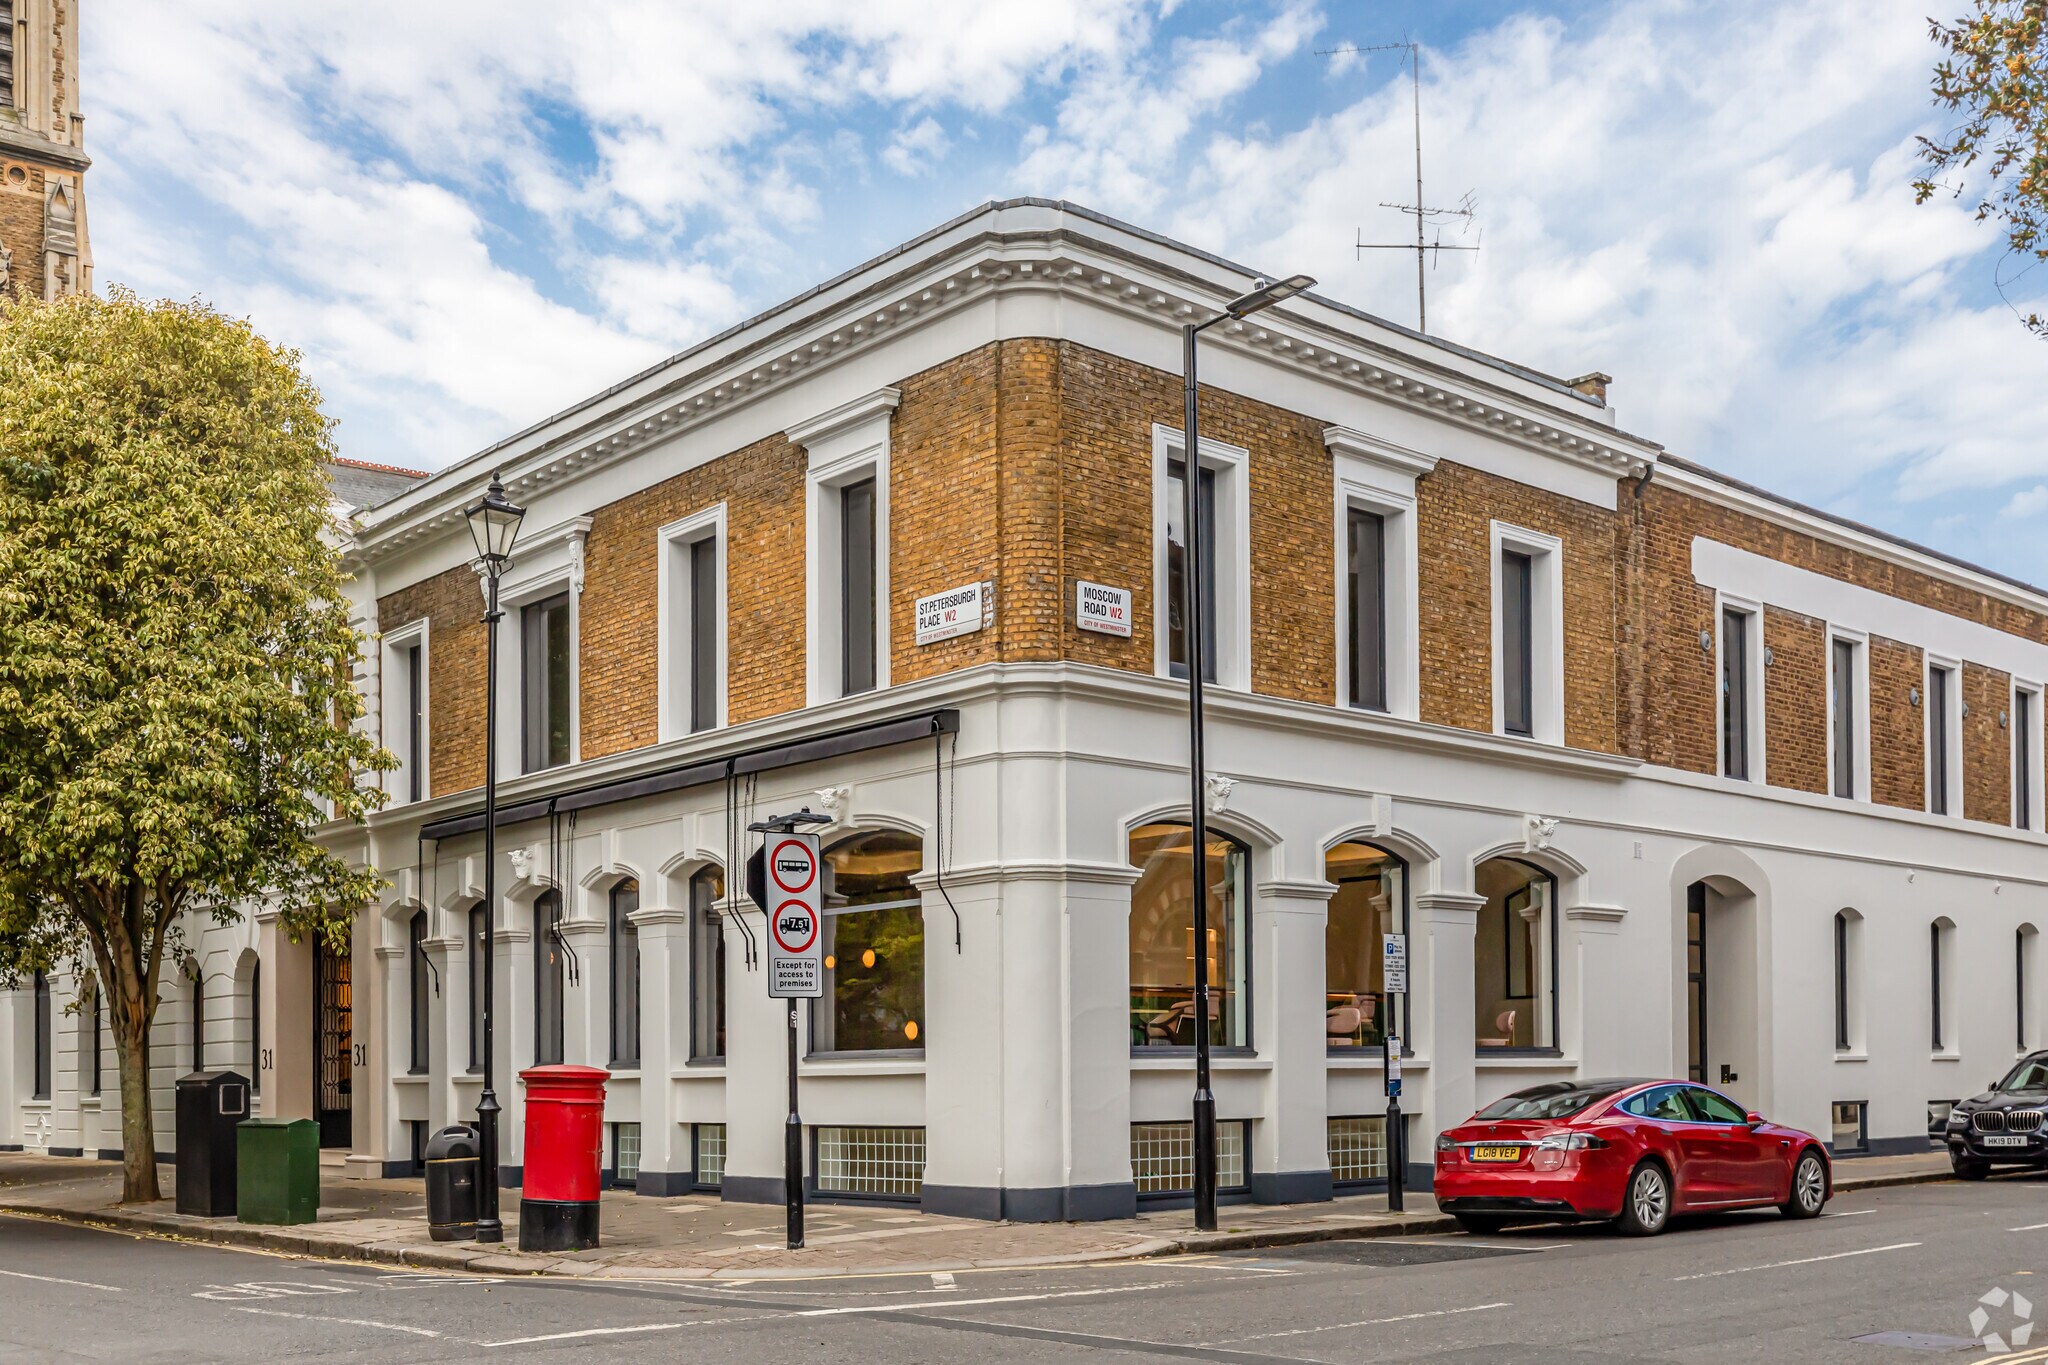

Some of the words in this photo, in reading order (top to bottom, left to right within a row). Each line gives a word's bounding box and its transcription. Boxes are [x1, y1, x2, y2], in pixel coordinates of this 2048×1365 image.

[1084, 587, 1121, 604] MOSCOW
[1084, 602, 1106, 616] ROAD
[1110, 606, 1122, 619] W2
[920, 614, 940, 629] PLACE
[945, 610, 957, 622] W2
[1100, 623, 1126, 633] WESTMINSTER
[791, 918, 809, 928] 7.5T
[776, 962, 801, 970] Except
[262, 1048, 273, 1069] 31
[354, 1044, 366, 1066] 31
[1477, 1148, 1497, 1158] LG18
[1500, 1148, 1516, 1158] VEP
